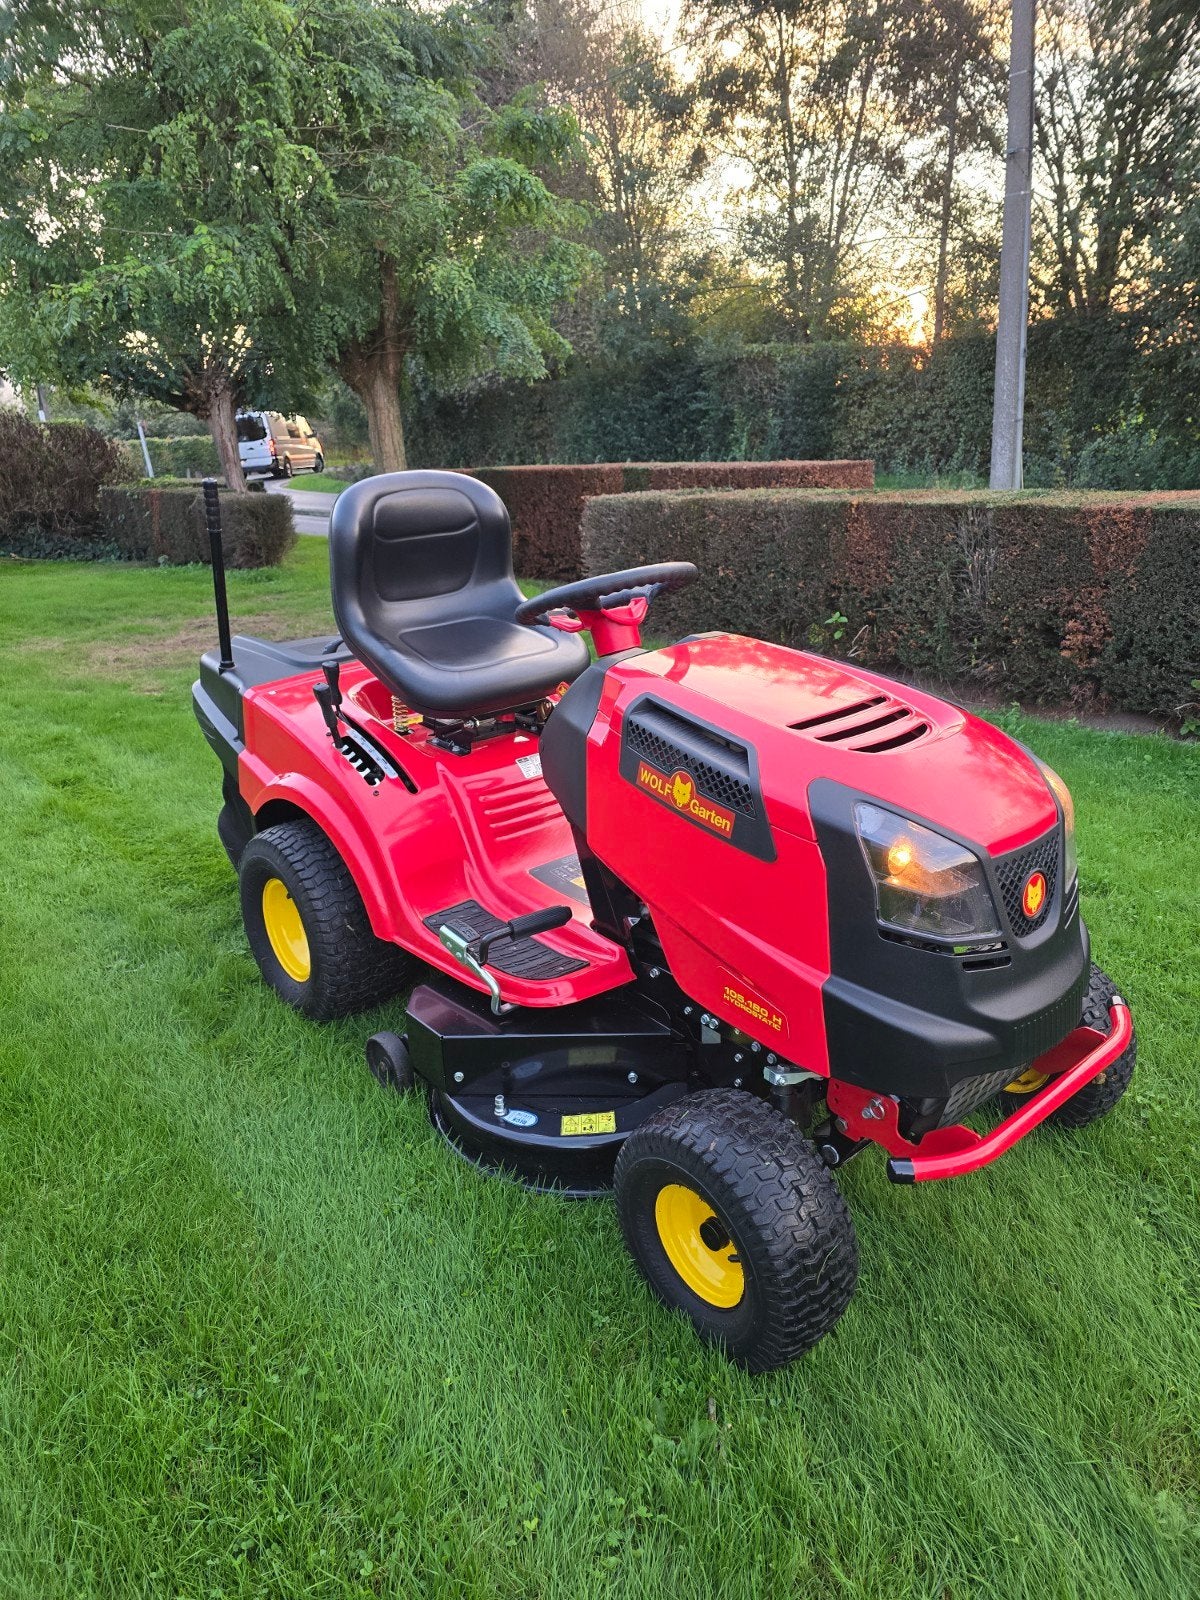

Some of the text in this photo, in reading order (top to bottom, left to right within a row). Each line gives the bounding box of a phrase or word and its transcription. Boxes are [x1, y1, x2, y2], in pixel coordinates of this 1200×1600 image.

[640, 767, 731, 832] WOLF Garten
[724, 993, 781, 1031] HYDROSTATIC
[772, 1014, 782, 1026] H
